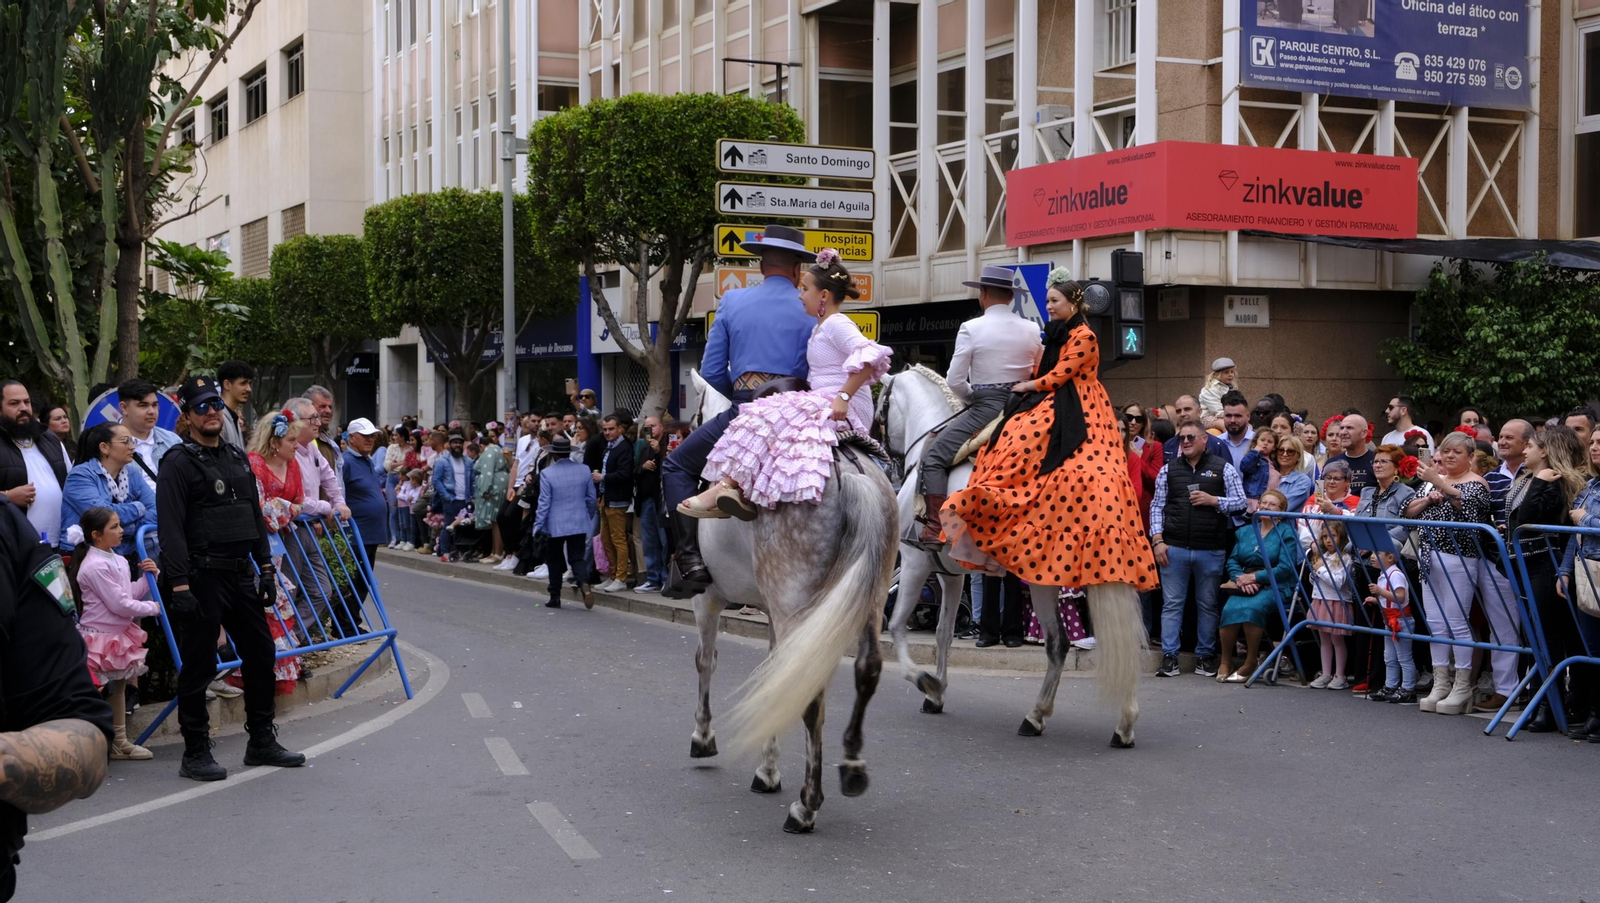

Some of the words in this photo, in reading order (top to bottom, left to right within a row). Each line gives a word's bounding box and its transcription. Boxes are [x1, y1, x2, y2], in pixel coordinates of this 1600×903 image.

[1401, 0, 1444, 13] Oficina
[1447, 3, 1466, 15] del
[1469, 4, 1496, 19] ático
[1499, 10, 1519, 22] con
[1437, 21, 1478, 37] terraza
[1280, 40, 1319, 53] PARQUE
[1321, 45, 1362, 59] CENTRO,
[1364, 49, 1381, 60] S.L.
[1280, 52, 1298, 61] Paseo
[1298, 54, 1306, 62] de
[1307, 55, 1329, 65] Almería
[1329, 57, 1338, 66] 43,
[1349, 60, 1371, 68] Almería
[1280, 62, 1346, 74] www.parquecentro.com
[1424, 54, 1444, 67] 635
[1446, 56, 1466, 70] 429
[1468, 59, 1487, 72] 076
[1424, 70, 1443, 83] 950
[1446, 72, 1466, 85] 275
[1468, 74, 1487, 87] 599
[786, 153, 818, 166] Santo
[821, 155, 870, 171] Domingo
[1107, 151, 1156, 165] www.zinkvalue.com
[820, 199, 835, 210] del
[838, 200, 870, 213] Aguila
[1014, 226, 1056, 240] ASESORAMIENTO
[1056, 222, 1087, 236] FINANCIERO
[1088, 221, 1093, 229] Y
[1094, 217, 1118, 230] GESTIÓN
[1118, 213, 1156, 226] PATRIMONIAL
[1186, 212, 1255, 225] ASESORAMIENTO
[1257, 216, 1305, 227] FINANCIERO
[1307, 218, 1313, 227] Y
[1315, 217, 1348, 229] GESTIÓN
[1350, 220, 1400, 232] PATRIMONIAL
[824, 233, 867, 246] hospital
[1240, 297, 1260, 306] CALLE
[906, 317, 916, 331] de
[919, 316, 960, 331] Descanso
[1235, 314, 1258, 324] MADRID
[532, 344, 547, 355] Equipos
[554, 342, 574, 353] Descanso
